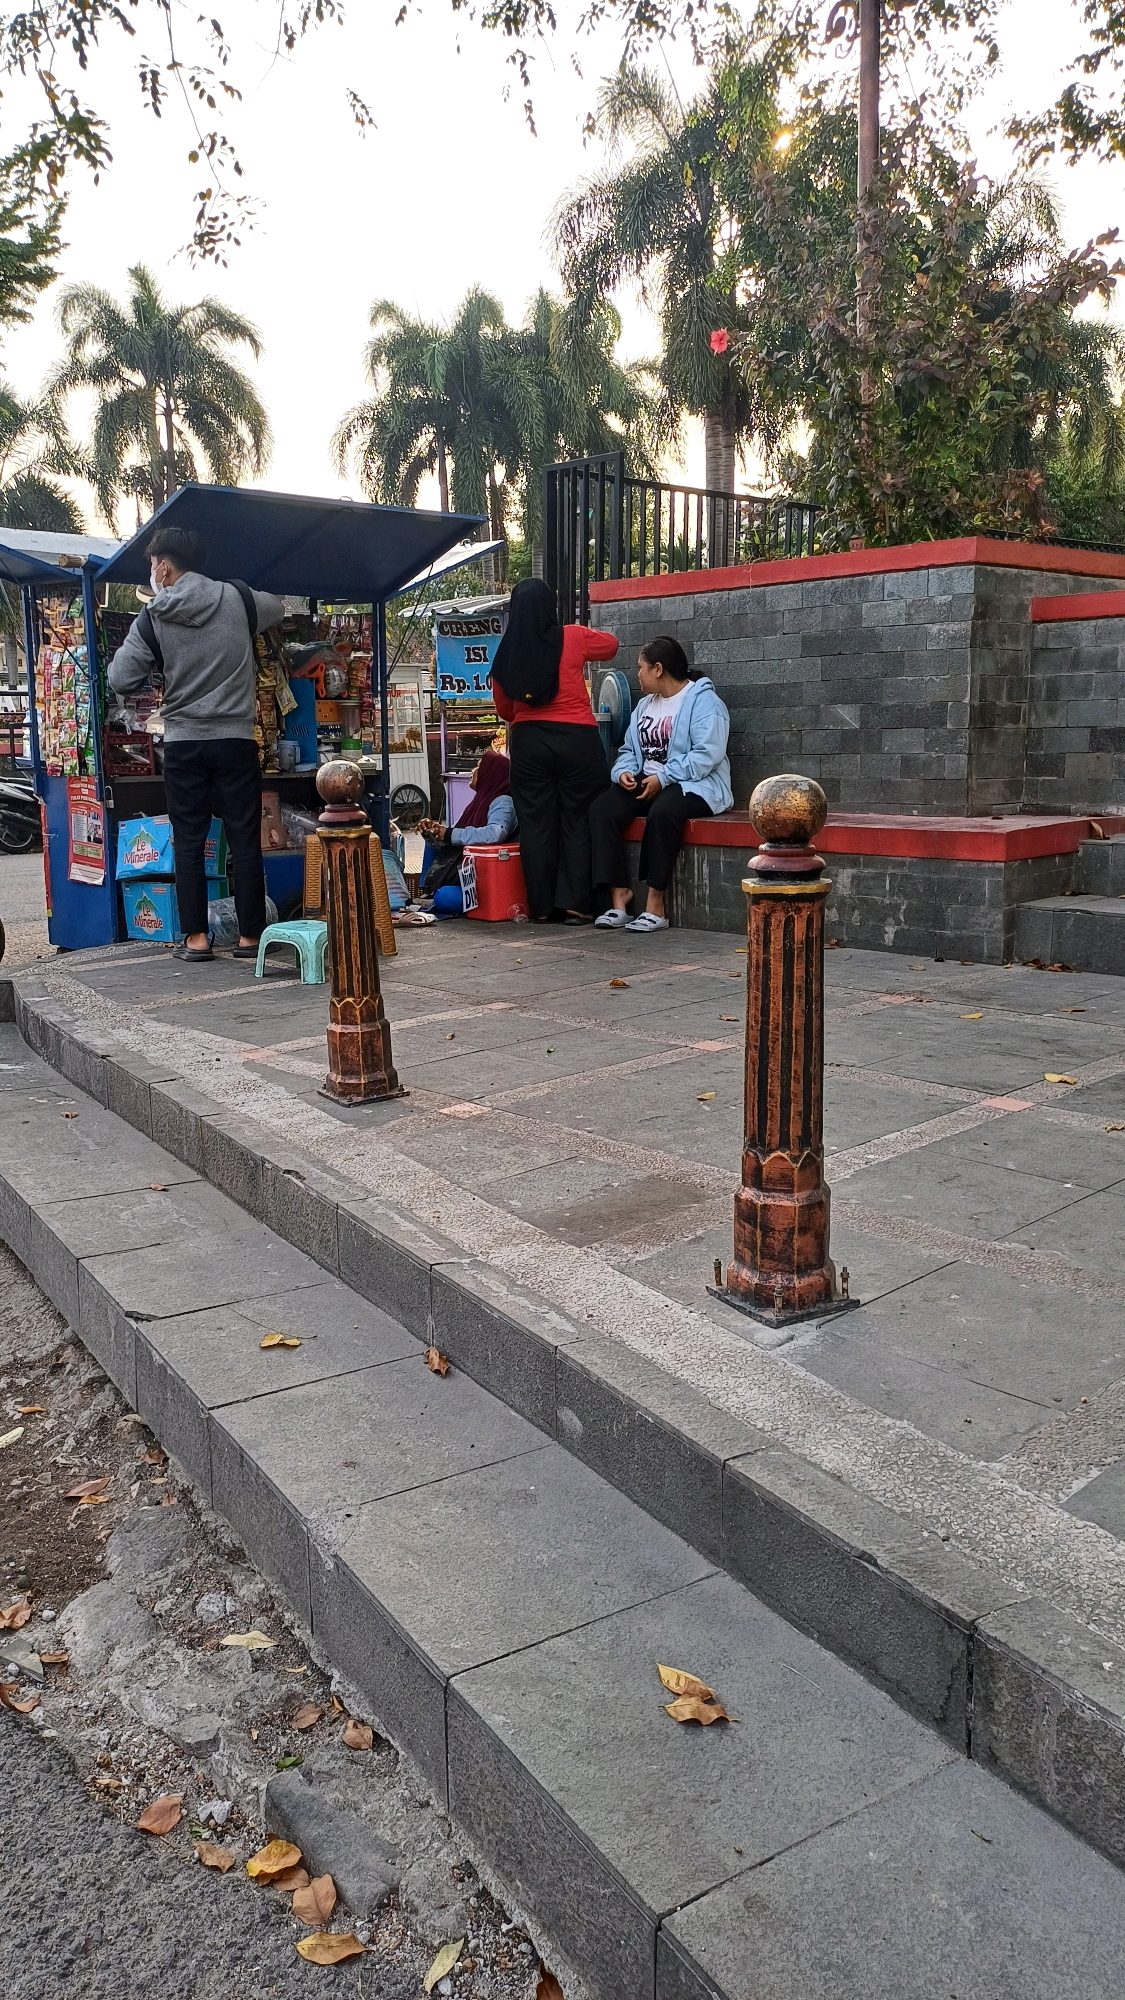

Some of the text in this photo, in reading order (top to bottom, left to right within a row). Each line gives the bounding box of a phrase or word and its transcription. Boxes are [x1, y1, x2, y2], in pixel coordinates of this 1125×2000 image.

[438, 617, 502, 637] CIRENG
[464, 646, 489, 664] ISI
[440, 674, 471, 693] Rp.
[136, 839, 146, 851] Le
[123, 849, 159, 865] Minerale
[142, 904, 151, 917] Le
[133, 914, 163, 930] Minerale
